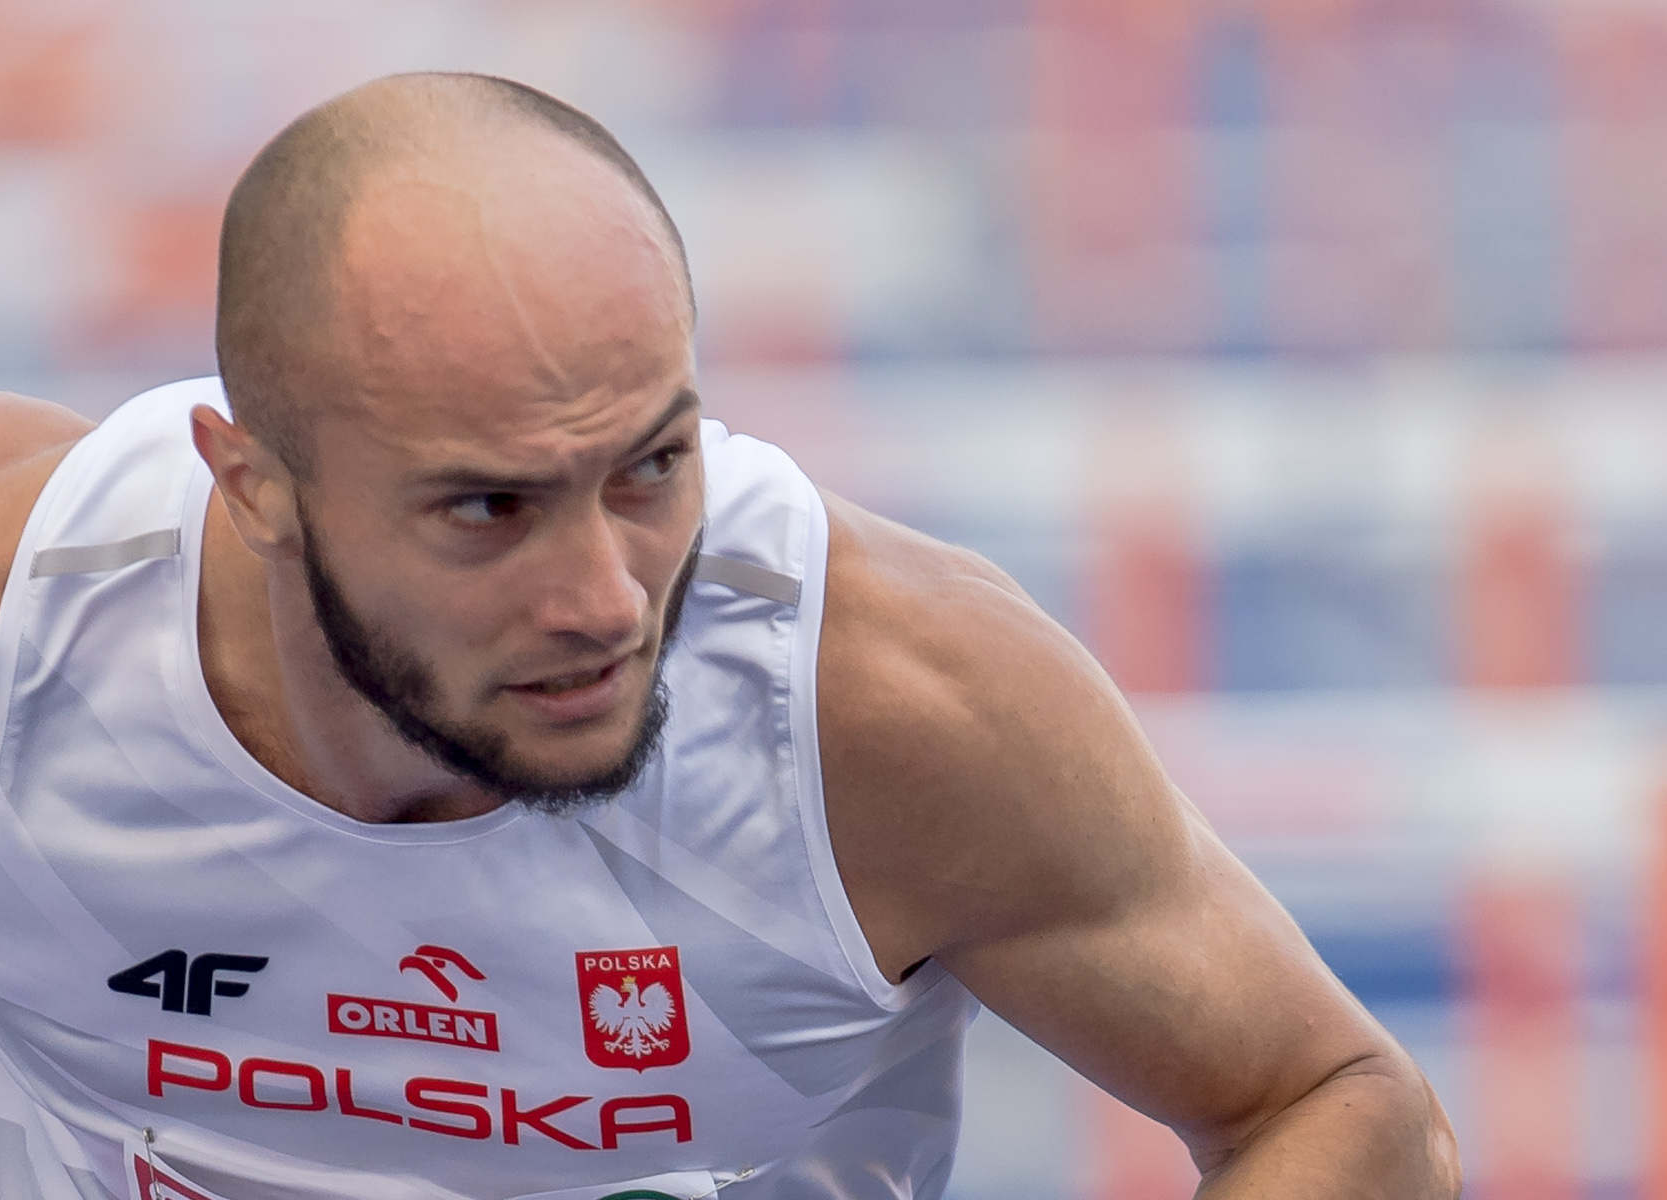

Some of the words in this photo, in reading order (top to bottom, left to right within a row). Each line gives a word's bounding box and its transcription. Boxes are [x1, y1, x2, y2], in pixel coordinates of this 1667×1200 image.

[107, 948, 270, 1017] 4F
[584, 953, 672, 972] POLSKA
[337, 1001, 487, 1045] ORLEN
[147, 1039, 693, 1150] POLSKA
